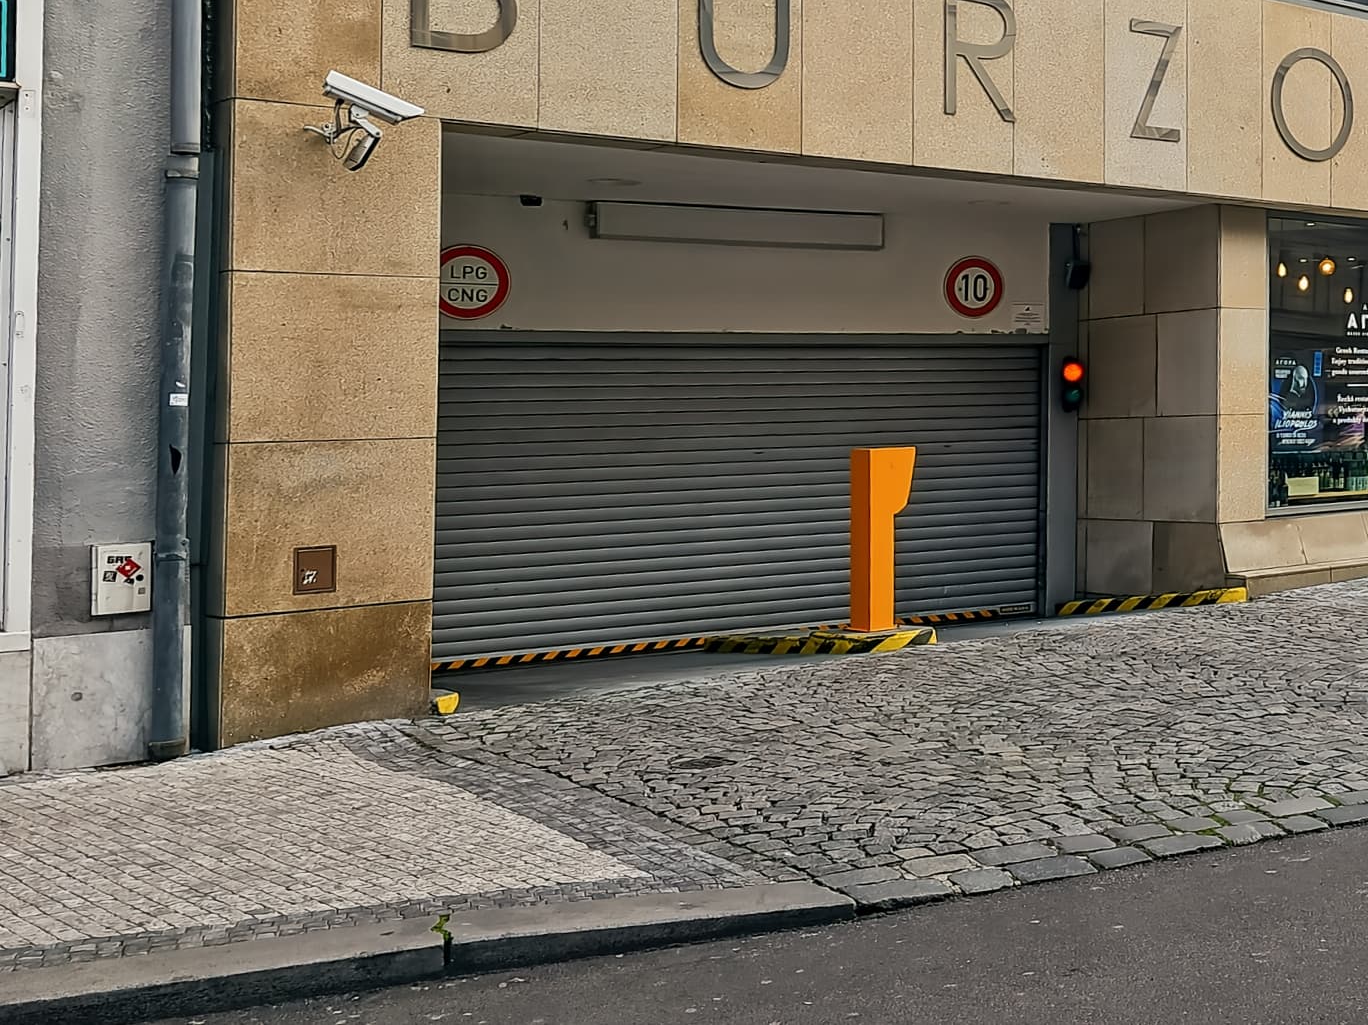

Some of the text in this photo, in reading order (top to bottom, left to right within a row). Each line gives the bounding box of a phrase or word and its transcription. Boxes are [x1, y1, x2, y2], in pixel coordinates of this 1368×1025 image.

[450, 265, 488, 280] LPG
[447, 287, 488, 303] CNG
[961, 273, 988, 303] 10
